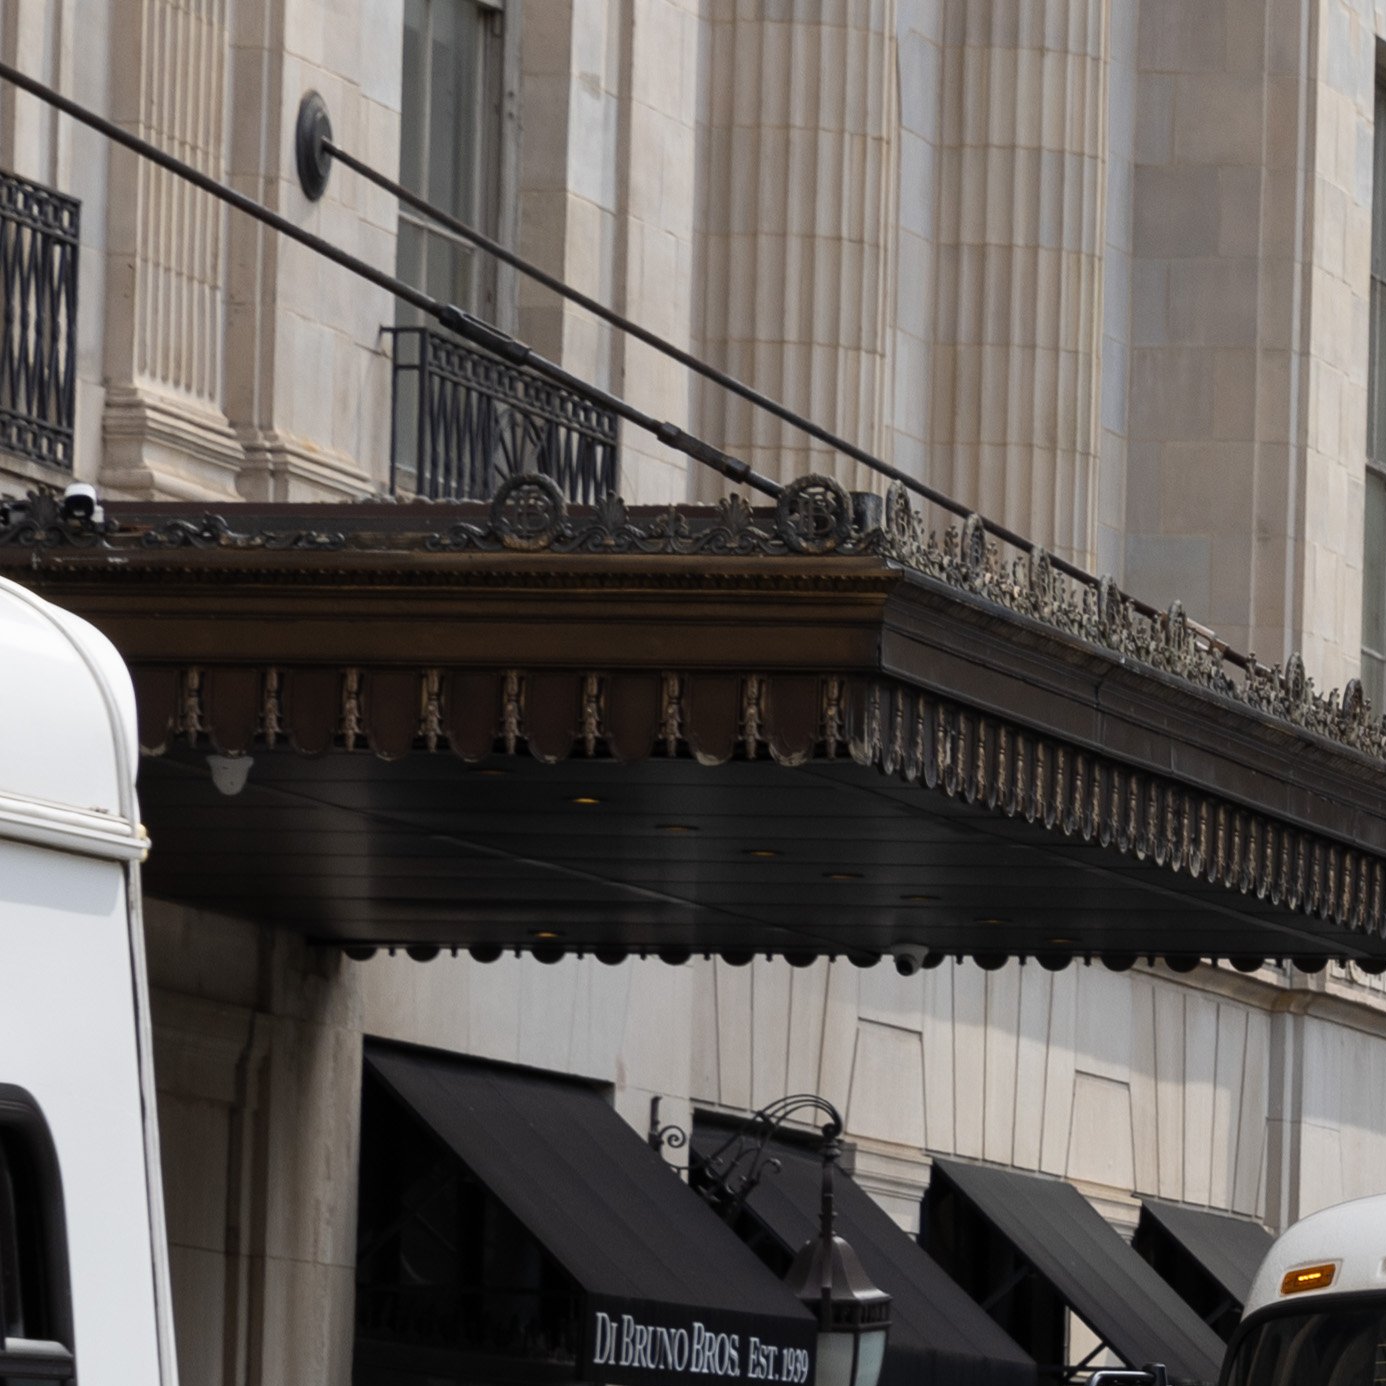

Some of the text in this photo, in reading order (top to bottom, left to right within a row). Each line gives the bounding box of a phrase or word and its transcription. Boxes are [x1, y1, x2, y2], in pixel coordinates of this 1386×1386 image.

[619, 1314, 689, 1372] BRUNO
[690, 1321, 741, 1377] BROS.
[747, 1336, 779, 1382] EST.
[781, 1347, 809, 1384] 1939
